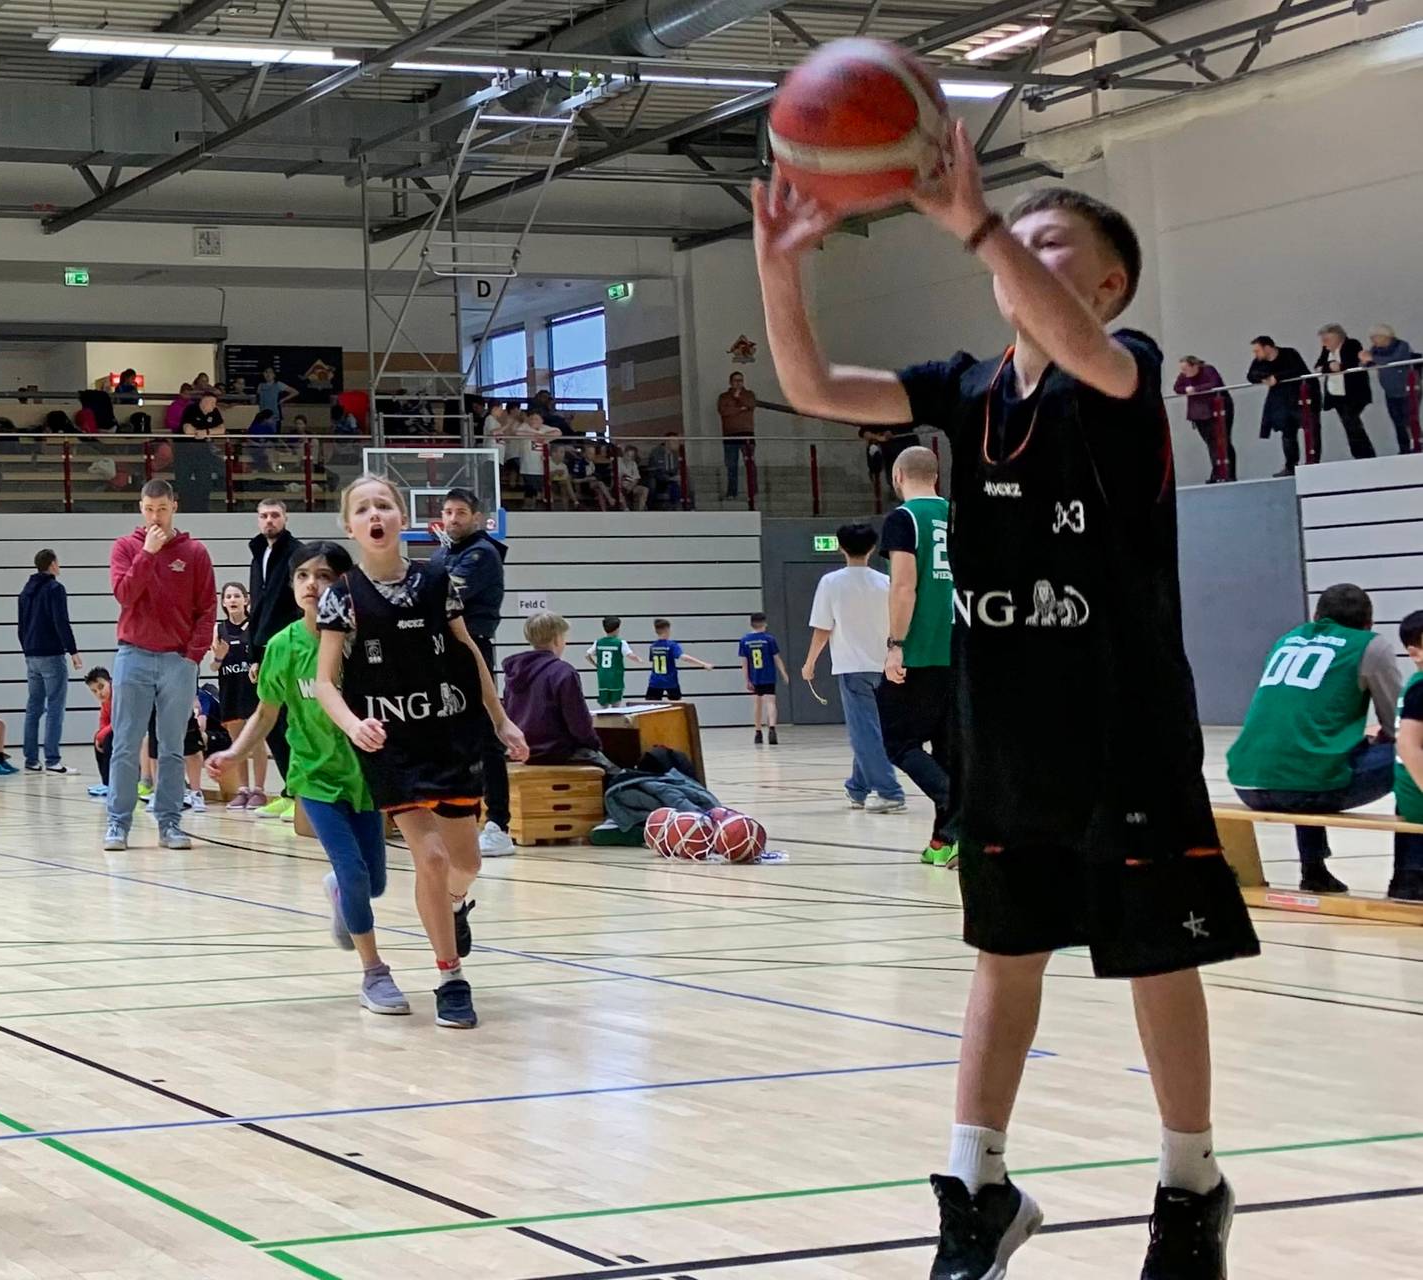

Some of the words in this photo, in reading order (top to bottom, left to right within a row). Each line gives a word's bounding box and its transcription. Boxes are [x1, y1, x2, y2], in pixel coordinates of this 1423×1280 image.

[477, 280, 491, 298] D
[519, 600, 538, 609] Feld
[539, 600, 546, 609] C
[950, 589, 1018, 629] NG
[601, 650, 613, 669] 8
[653, 655, 668, 675] 11
[752, 648, 764, 669] 8
[1259, 645, 1336, 690] 00
[222, 663, 240, 676] ING
[364, 691, 432, 722] ING
